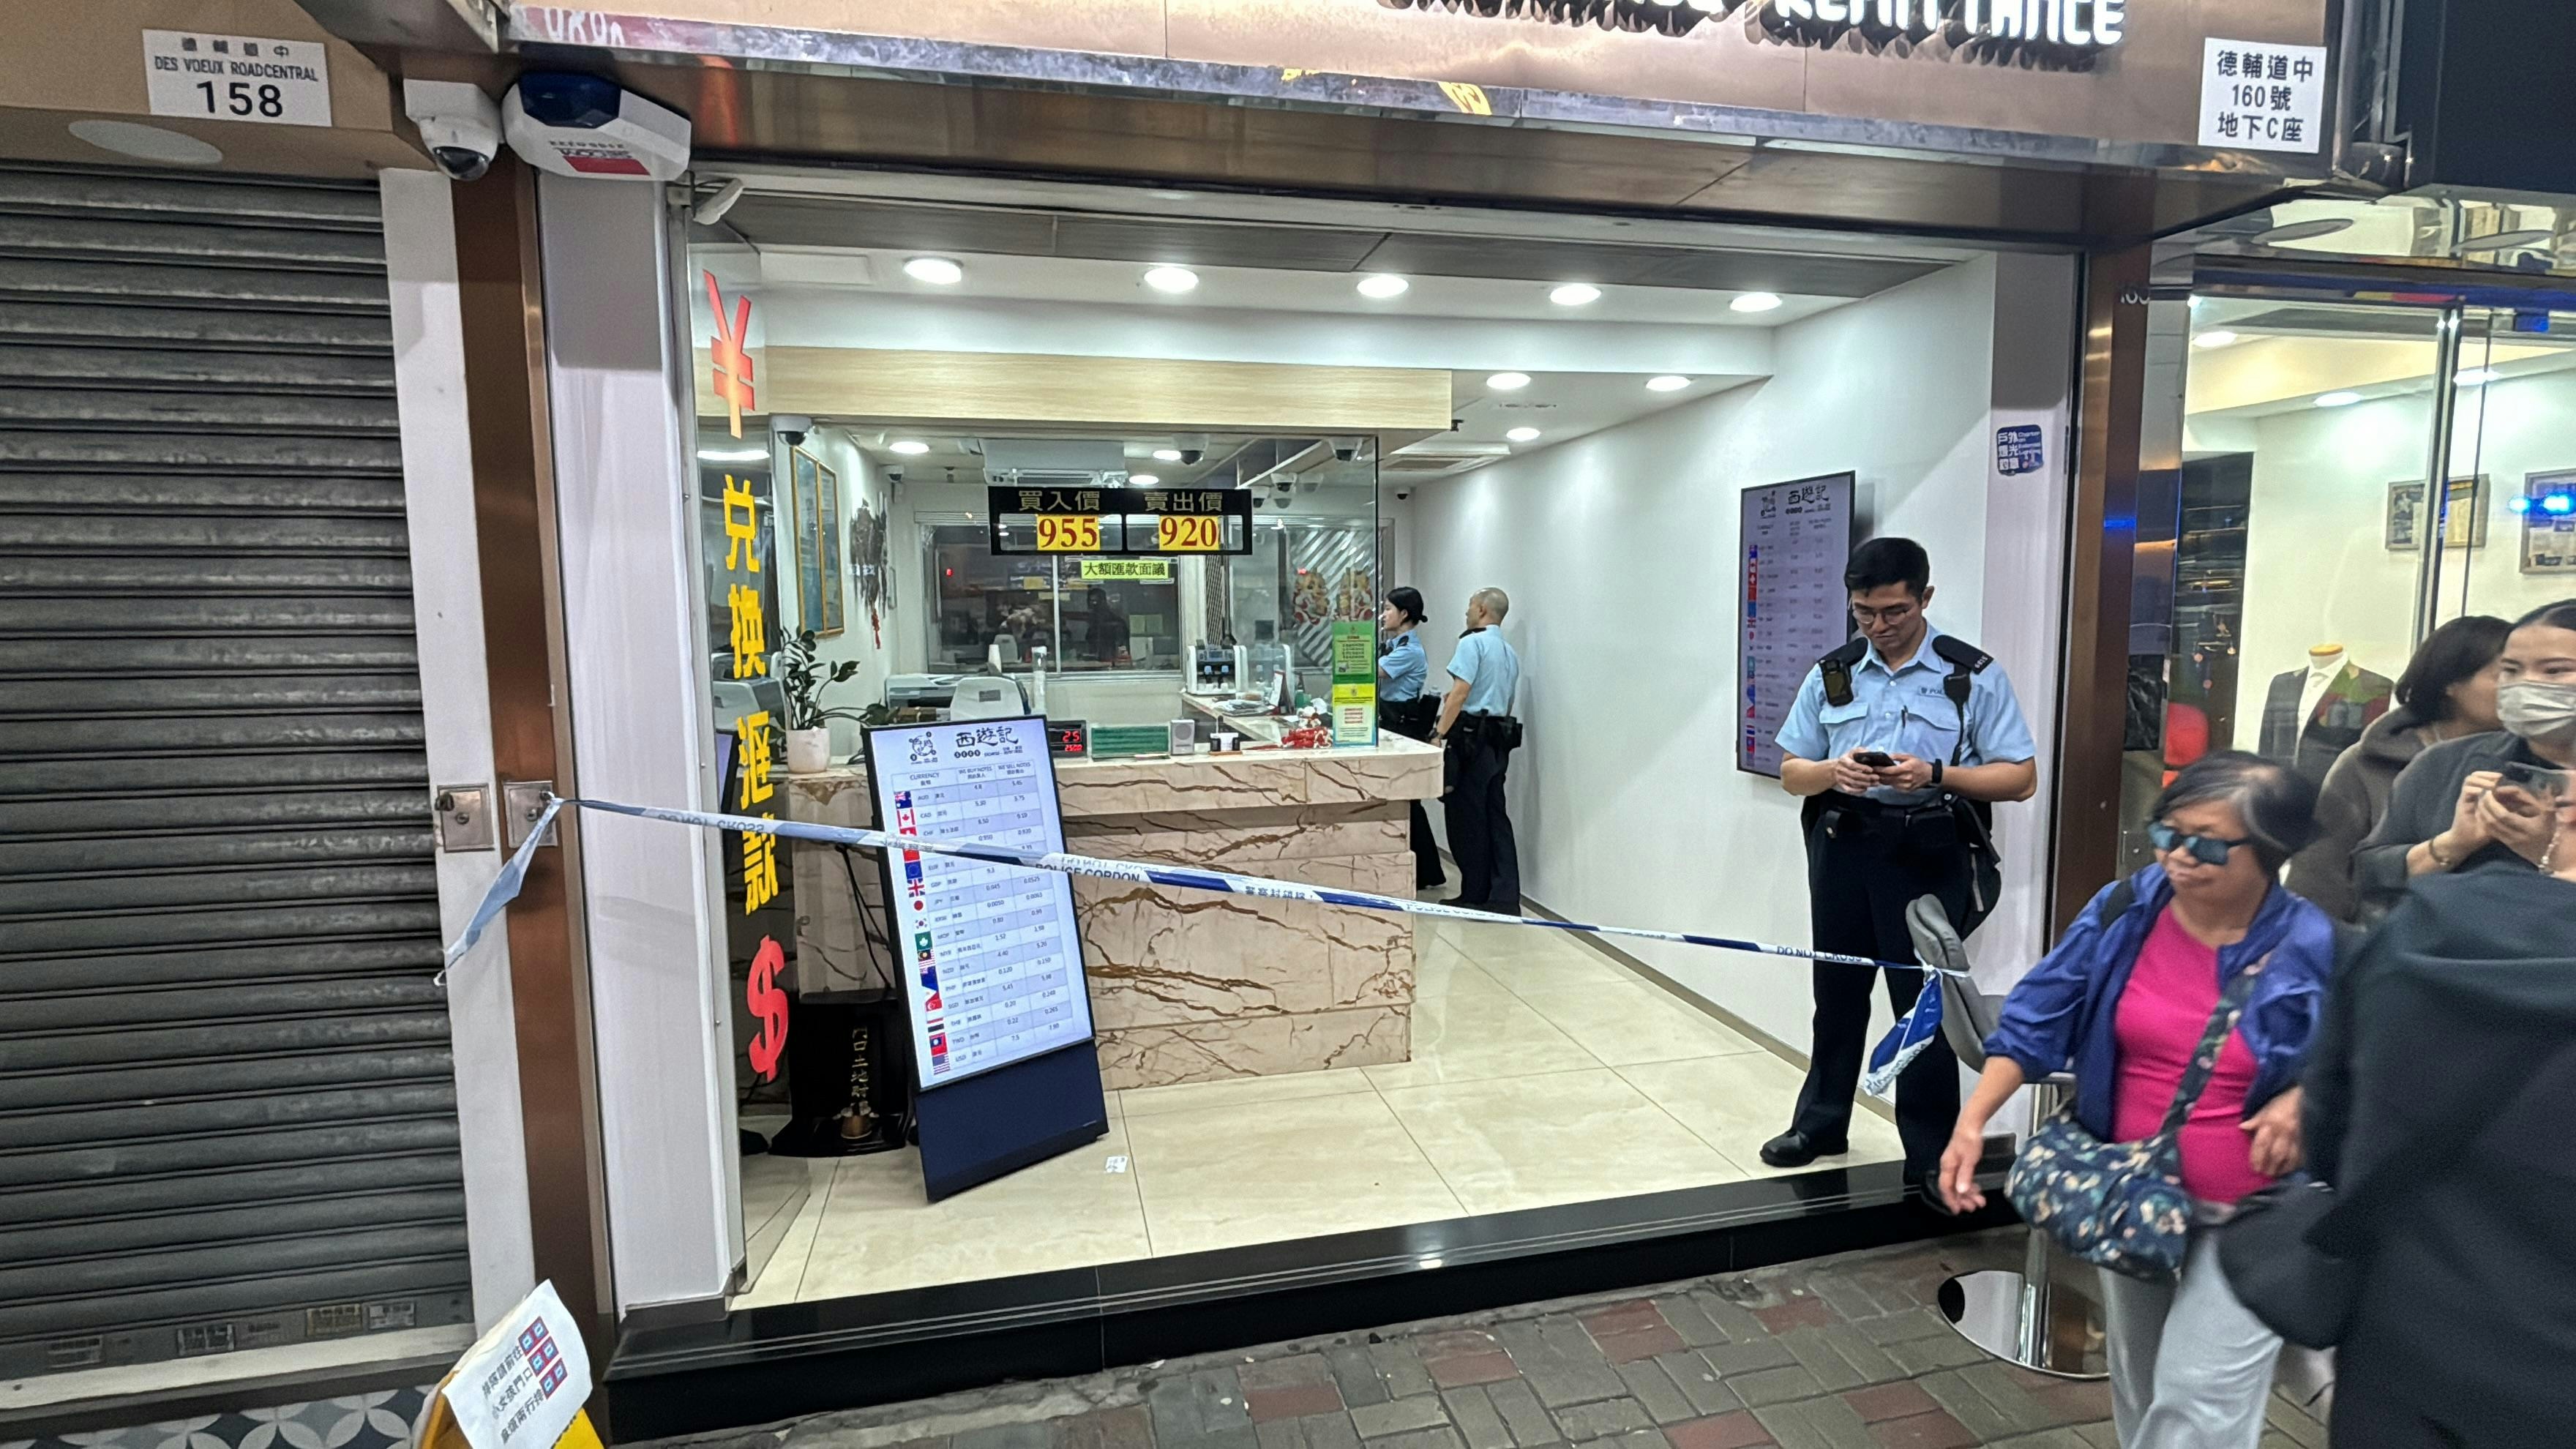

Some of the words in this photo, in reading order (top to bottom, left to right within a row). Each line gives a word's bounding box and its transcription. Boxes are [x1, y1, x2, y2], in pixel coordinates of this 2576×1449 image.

[154, 56, 179, 71] DES
[184, 59, 225, 74] VOEUX
[2217, 50, 2313, 83] 德輔道中
[197, 80, 283, 117] 158
[2233, 84, 2291, 111] 160號
[2217, 112, 2304, 142] 地下C座
[1019, 490, 1100, 511] 買入價
[1145, 492, 1223, 512] 賣出價
[1789, 485, 1830, 504] 西遊記
[1038, 518, 1098, 547] 955
[1160, 517, 1218, 547] 920
[1084, 562, 1166, 576] 大額匯款面議
[956, 726, 1018, 747] 西遊記
[910, 772, 939, 780] CURRENCY
